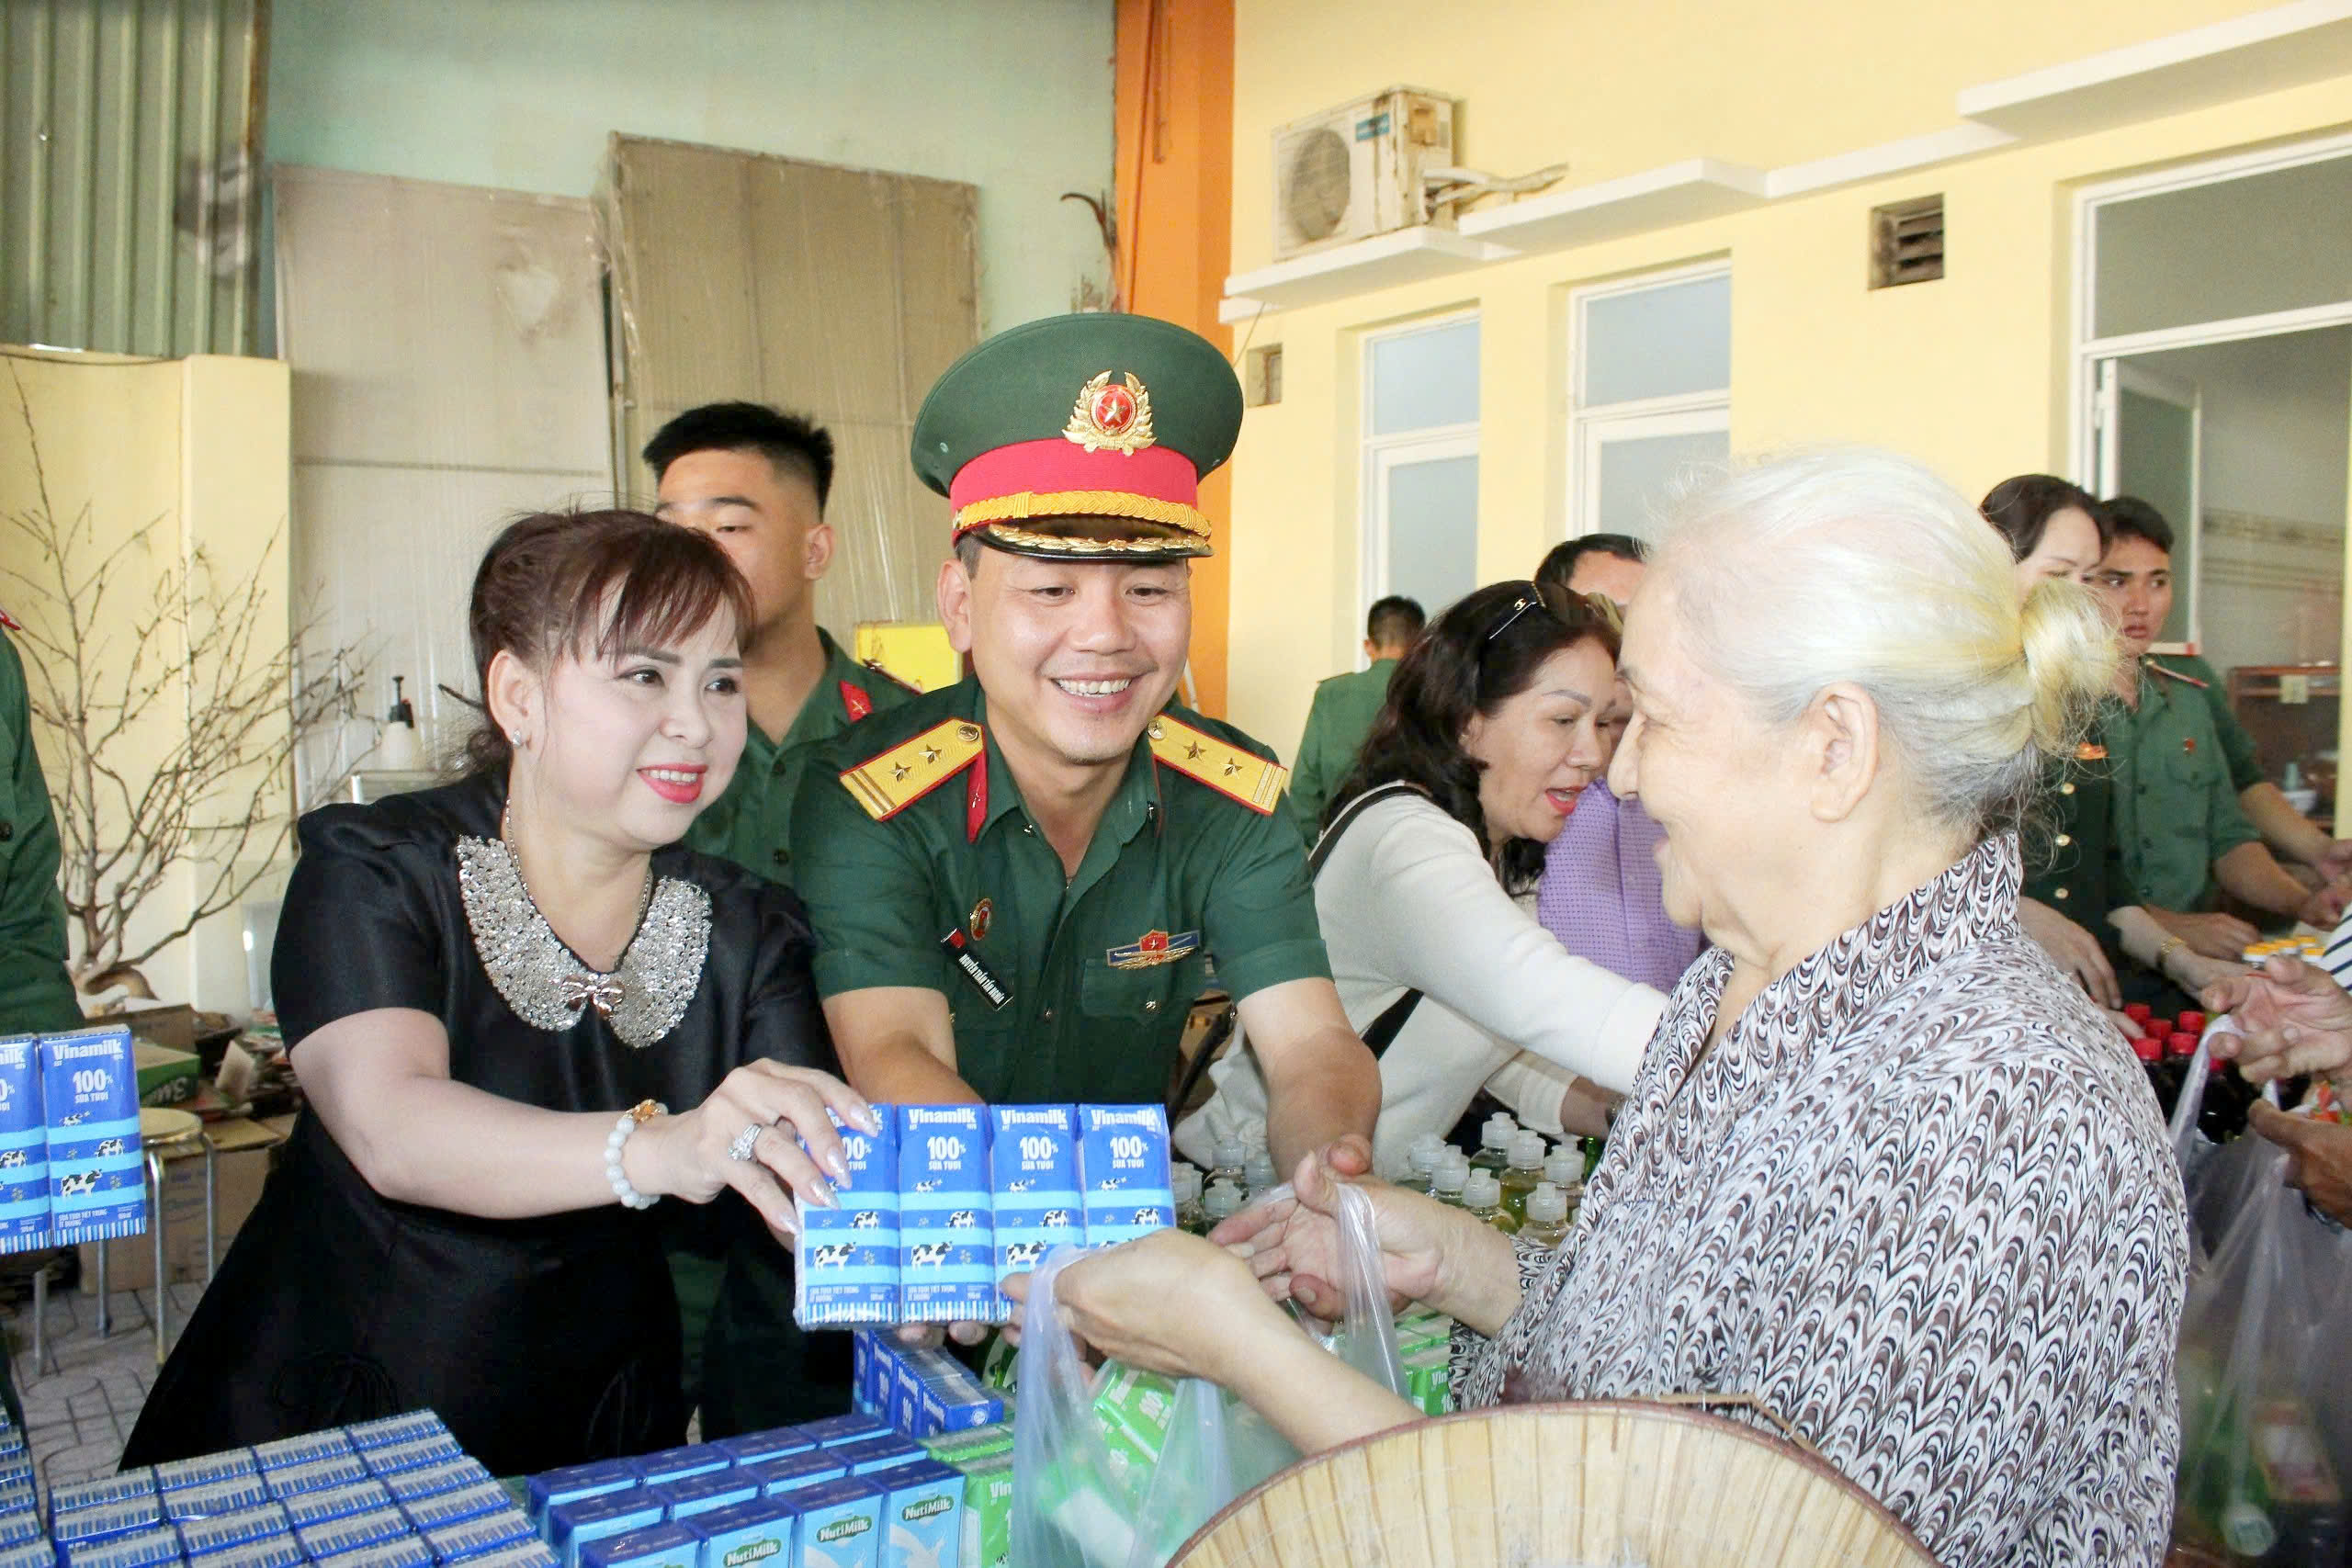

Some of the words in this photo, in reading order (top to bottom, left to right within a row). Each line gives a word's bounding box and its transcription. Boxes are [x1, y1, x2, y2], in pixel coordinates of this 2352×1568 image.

[52, 1039, 123, 1060] Vinamilk
[908, 1108, 976, 1124] Vinamilk
[1000, 1109, 1068, 1125] Vinamilk
[1091, 1108, 1159, 1126] Vinamilk
[842, 1136, 872, 1160] 00%
[905, 1496, 952, 1520] NutiMilk
[820, 1518, 870, 1541] NutiMilk
[727, 1541, 779, 1566] NutiMilk
